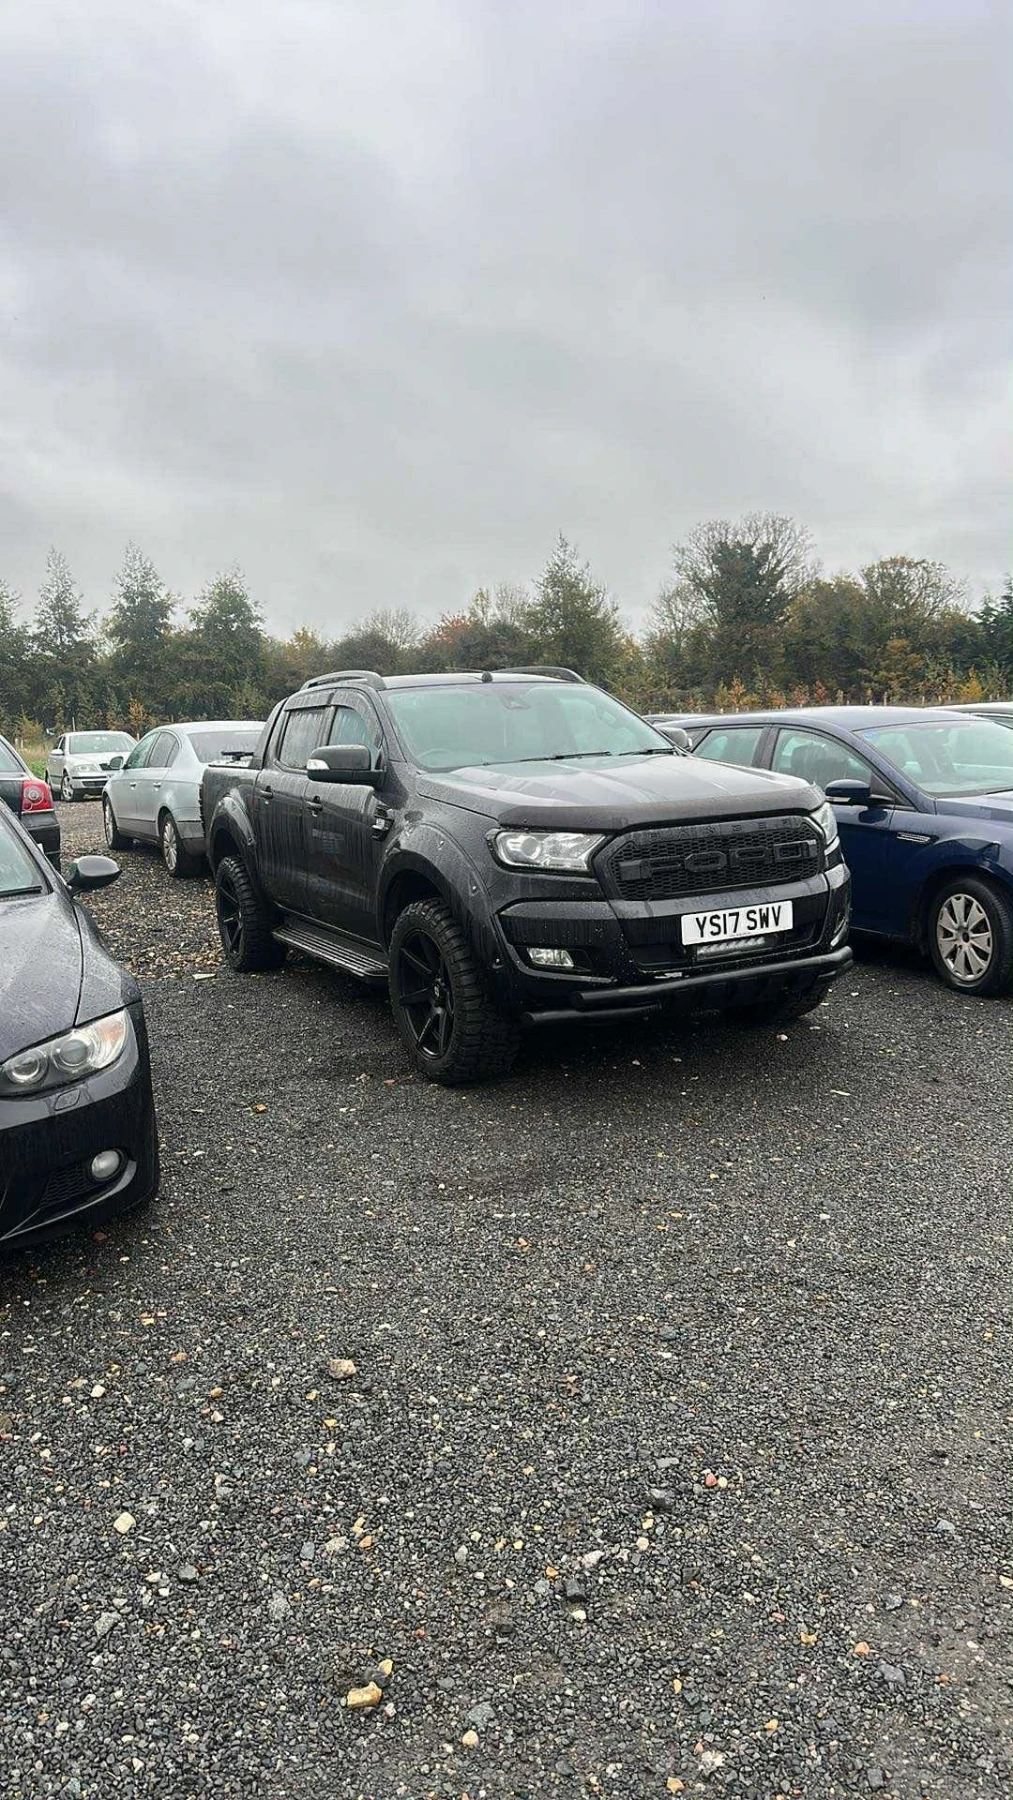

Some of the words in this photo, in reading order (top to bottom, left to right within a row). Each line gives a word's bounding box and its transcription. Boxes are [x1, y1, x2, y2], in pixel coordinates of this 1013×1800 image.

[619, 839, 817, 881] FORD
[695, 911, 740, 939] YS17
[746, 905, 782, 931] SWV
